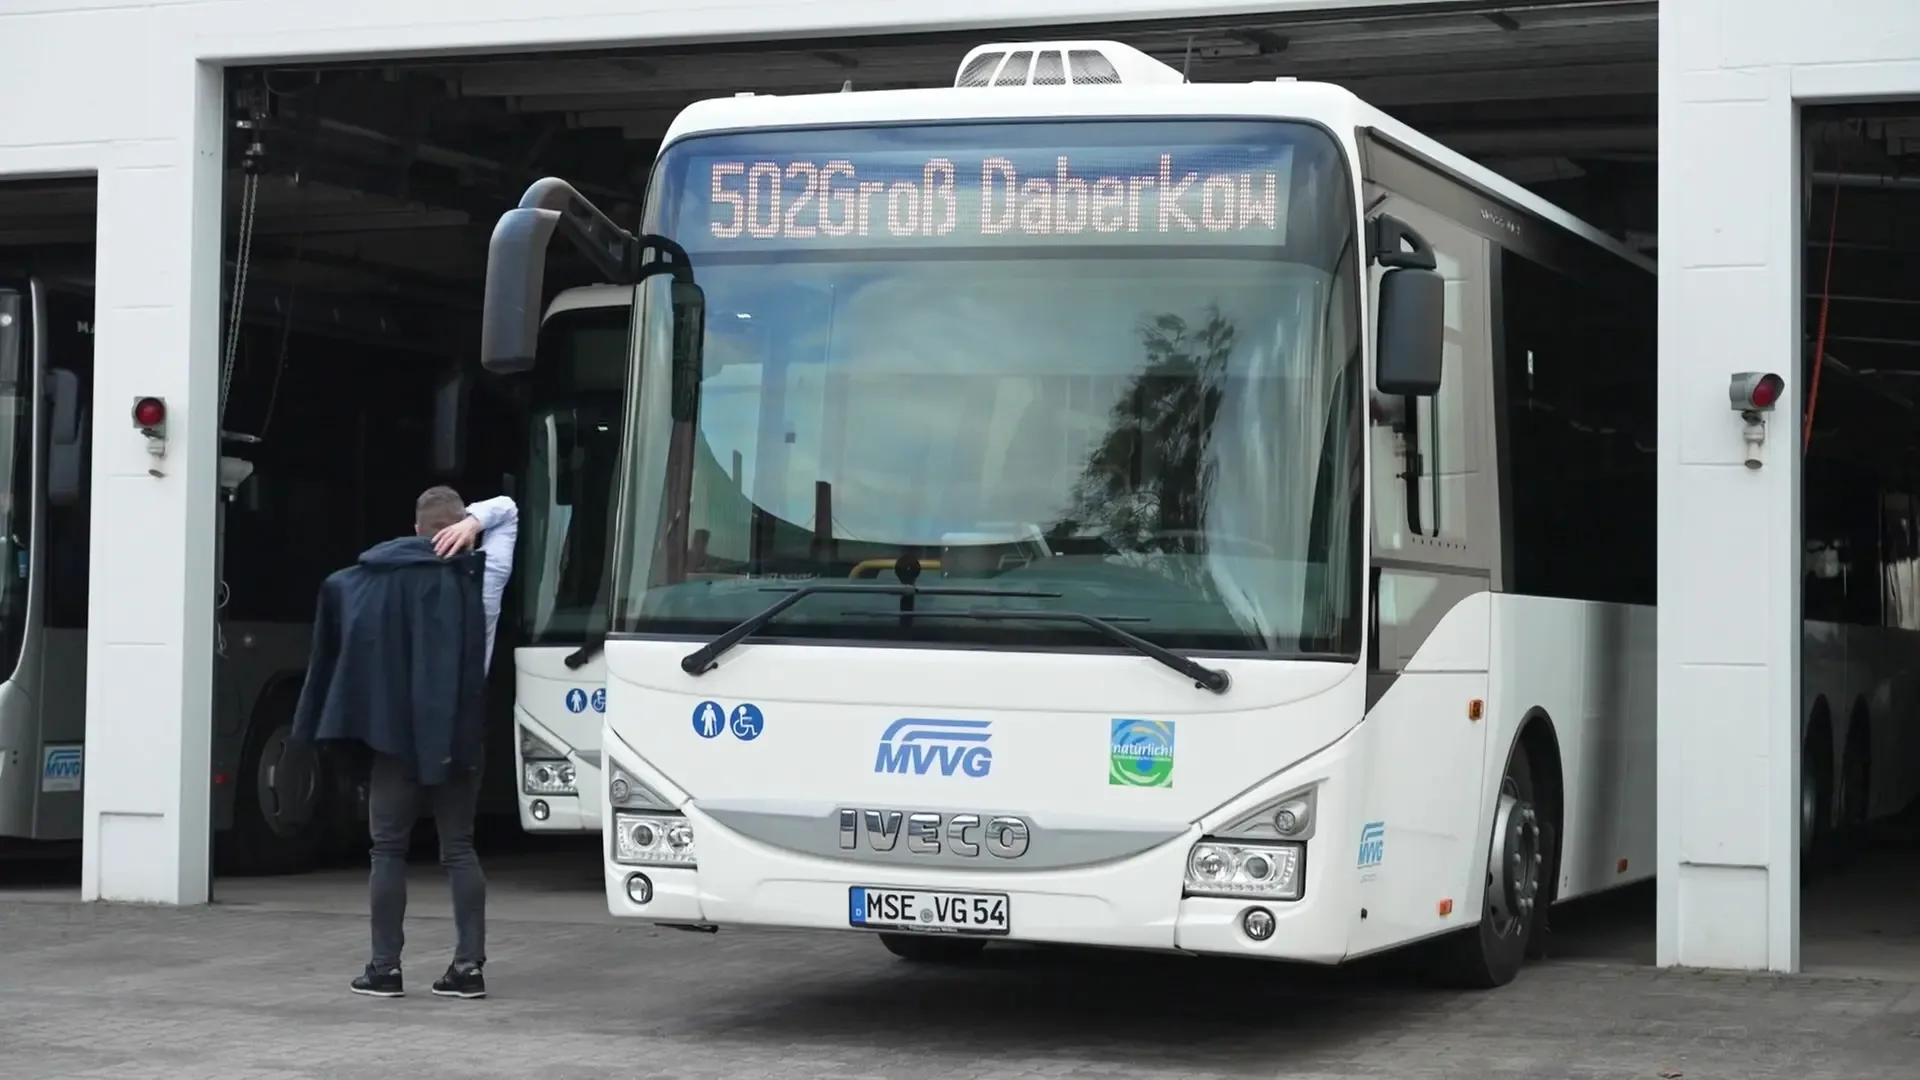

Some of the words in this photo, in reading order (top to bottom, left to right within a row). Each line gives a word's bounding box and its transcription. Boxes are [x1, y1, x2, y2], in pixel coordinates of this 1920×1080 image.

[980, 152, 1277, 235] Daberkow
[874, 742, 993, 778] MVVG
[839, 807, 1030, 860] IVECO
[866, 892, 917, 921] MSE
